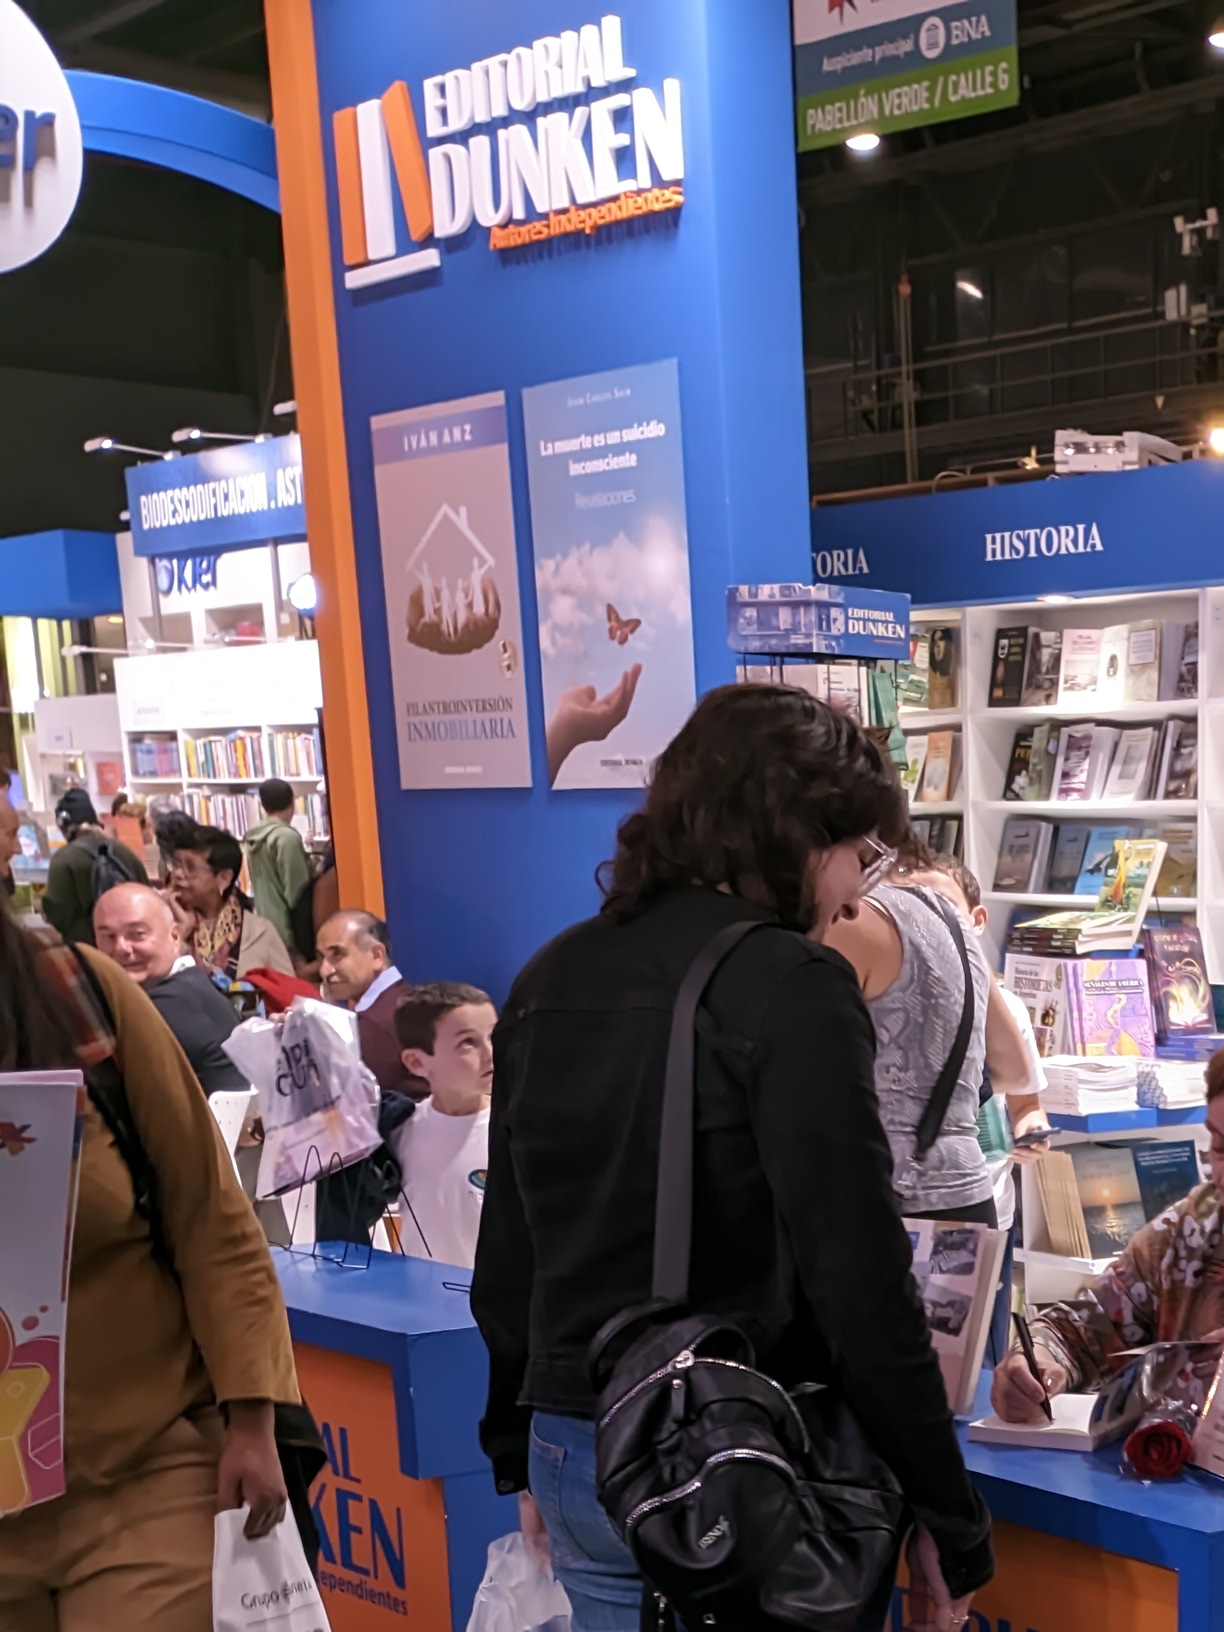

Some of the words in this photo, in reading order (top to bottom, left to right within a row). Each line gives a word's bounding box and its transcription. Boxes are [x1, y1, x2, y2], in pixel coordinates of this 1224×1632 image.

[874, 34, 915, 64] principal
[949, 14, 992, 46] BNA
[423, 14, 637, 138] EDITORIAL
[806, 87, 879, 136] PABELLÓN
[881, 80, 930, 118] VERDE
[934, 76, 944, 109] /
[949, 68, 994, 102] CALLE
[997, 62, 1009, 91] 6
[428, 77, 685, 238] DUNKEN
[489, 218, 549, 250] Autores
[549, 186, 685, 234] Independientes
[404, 428, 438, 452] IVÁN
[442, 424, 472, 444] ANZ
[540, 440, 553, 457] La
[592, 433, 606, 447] es
[606, 431, 621, 445] un
[622, 419, 666, 443] suicidio
[985, 522, 1103, 562] HISTORIA
[848, 608, 895, 622] EDITORIAL
[848, 621, 905, 639] DUNKEN
[406, 695, 513, 717] FILANTROINVERSIÓN
[407, 717, 516, 743] INMOBILIARIA
